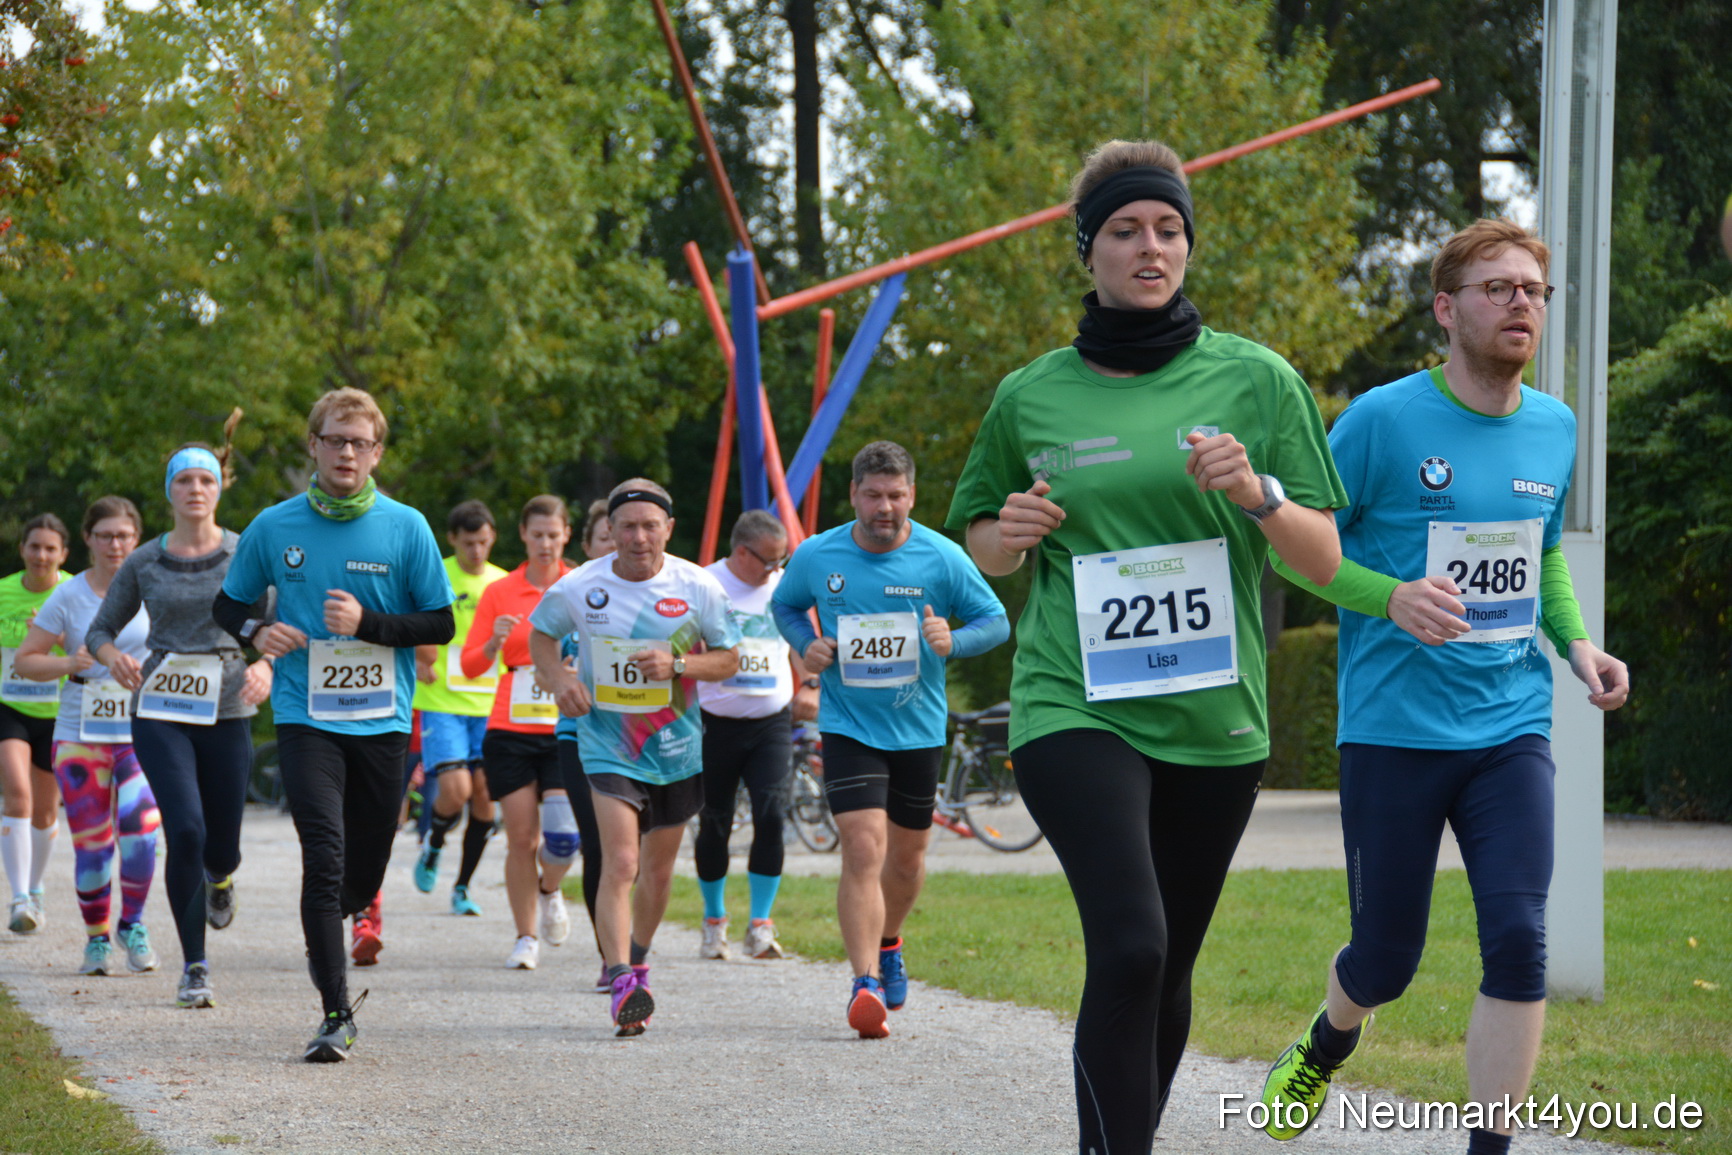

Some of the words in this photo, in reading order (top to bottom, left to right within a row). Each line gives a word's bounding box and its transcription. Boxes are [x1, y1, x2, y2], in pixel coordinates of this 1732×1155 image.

[1423, 458, 1449, 469] BMW
[1512, 478, 1556, 500] BOCK
[1420, 495, 1455, 504] PARTL
[1420, 504, 1455, 512] Neumarkt
[1479, 532, 1516, 544] BOCK
[346, 560, 389, 573] BOCK
[1133, 558, 1184, 575] BOCK
[1447, 557, 1527, 594] 2486
[884, 586, 924, 597] BOCK
[659, 602, 685, 612] Hervis
[1101, 587, 1211, 641] 2215
[1465, 608, 1508, 621] Thomas
[850, 636, 906, 659] 2487
[1147, 653, 1178, 669] Lisa
[322, 664, 383, 688] 2233
[610, 662, 648, 684] 16
[867, 666, 893, 674] Adrian
[154, 673, 208, 696] 2020
[338, 697, 369, 706] Nathan
[616, 691, 646, 700] Norbert
[163, 700, 193, 710] Kristina
